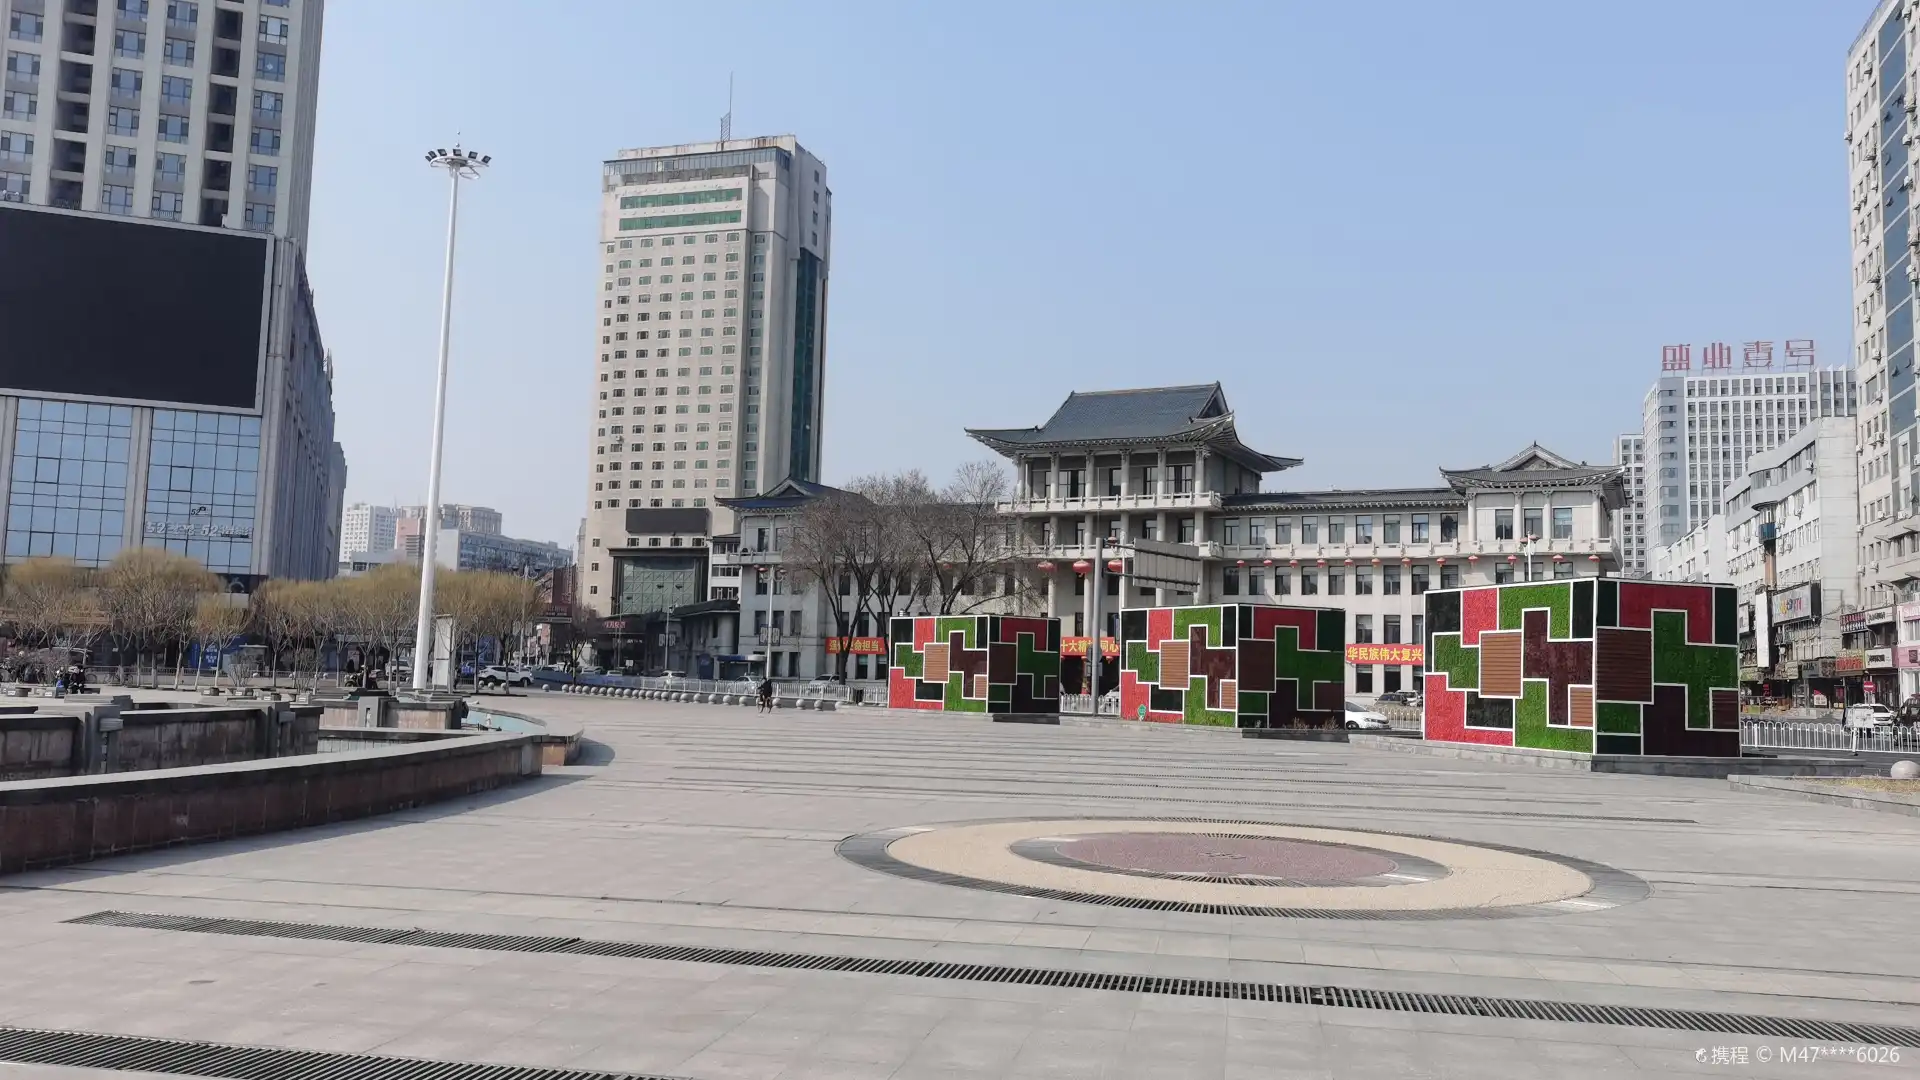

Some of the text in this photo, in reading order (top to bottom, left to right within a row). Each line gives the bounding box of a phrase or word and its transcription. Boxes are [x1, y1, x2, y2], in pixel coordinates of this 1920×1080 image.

[1061, 639, 1120, 653] 十大精同心
[1345, 646, 1424, 662] 华民族伟大复兴
